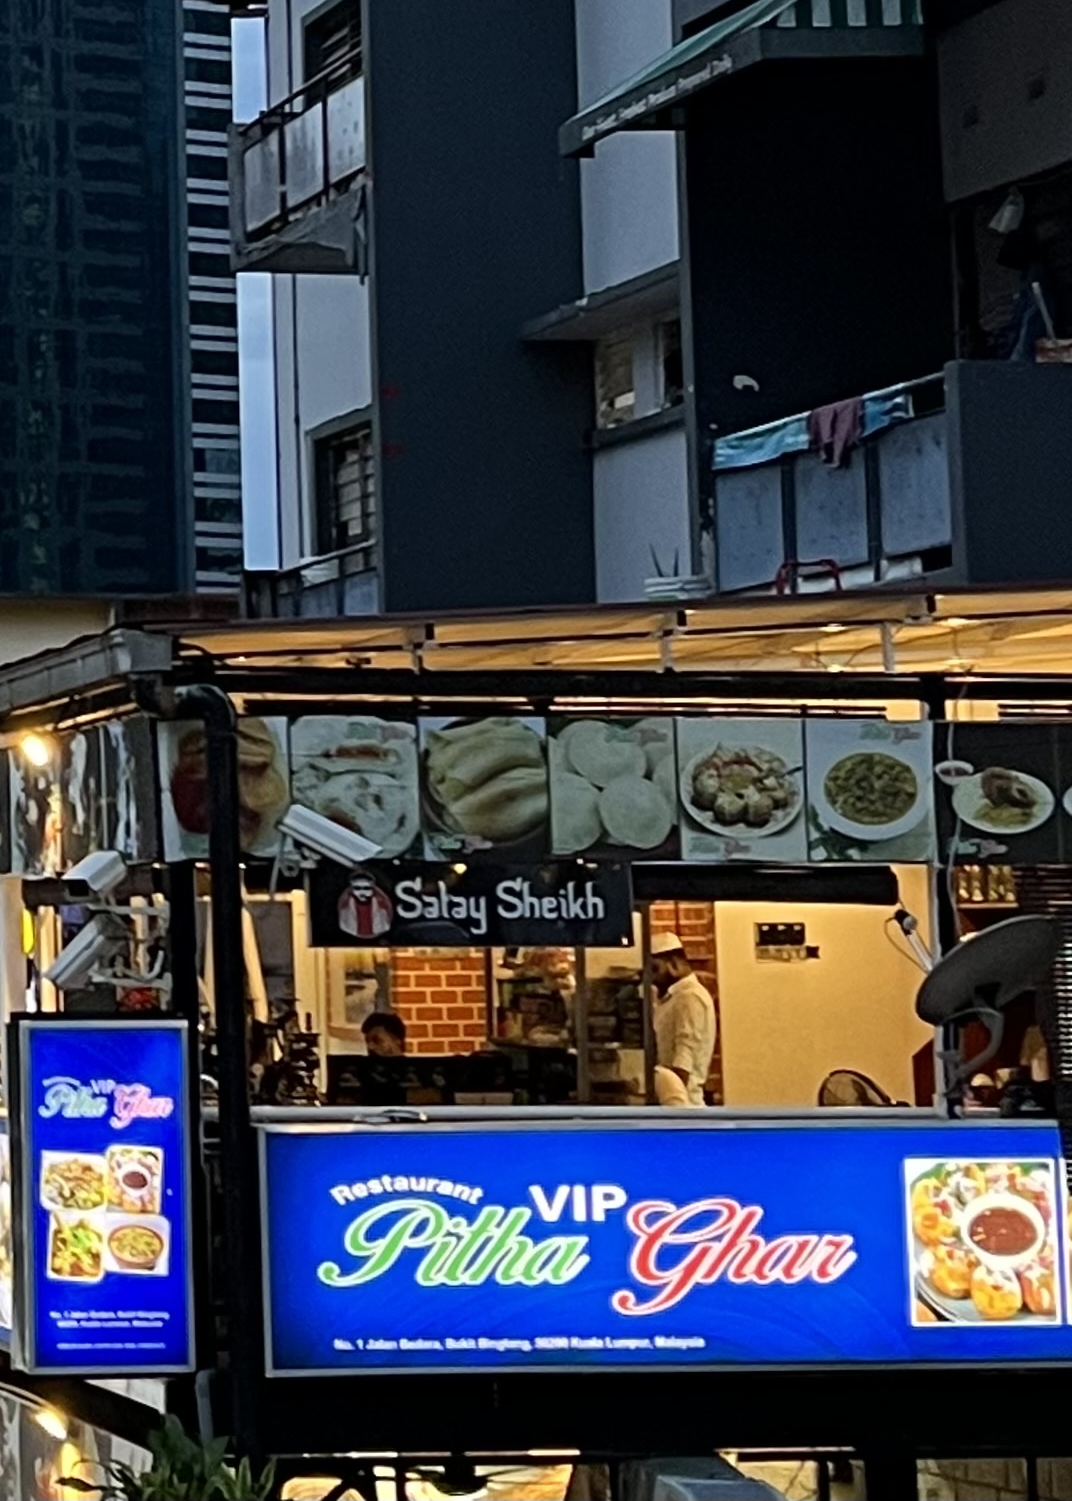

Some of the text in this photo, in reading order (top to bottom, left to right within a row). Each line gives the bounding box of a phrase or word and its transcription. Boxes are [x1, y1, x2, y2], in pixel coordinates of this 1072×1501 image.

[495, 876, 605, 920] Sheikh
[329, 1174, 628, 1223] Restaurant VIP
[317, 1197, 858, 1316] Pitha Ghar
